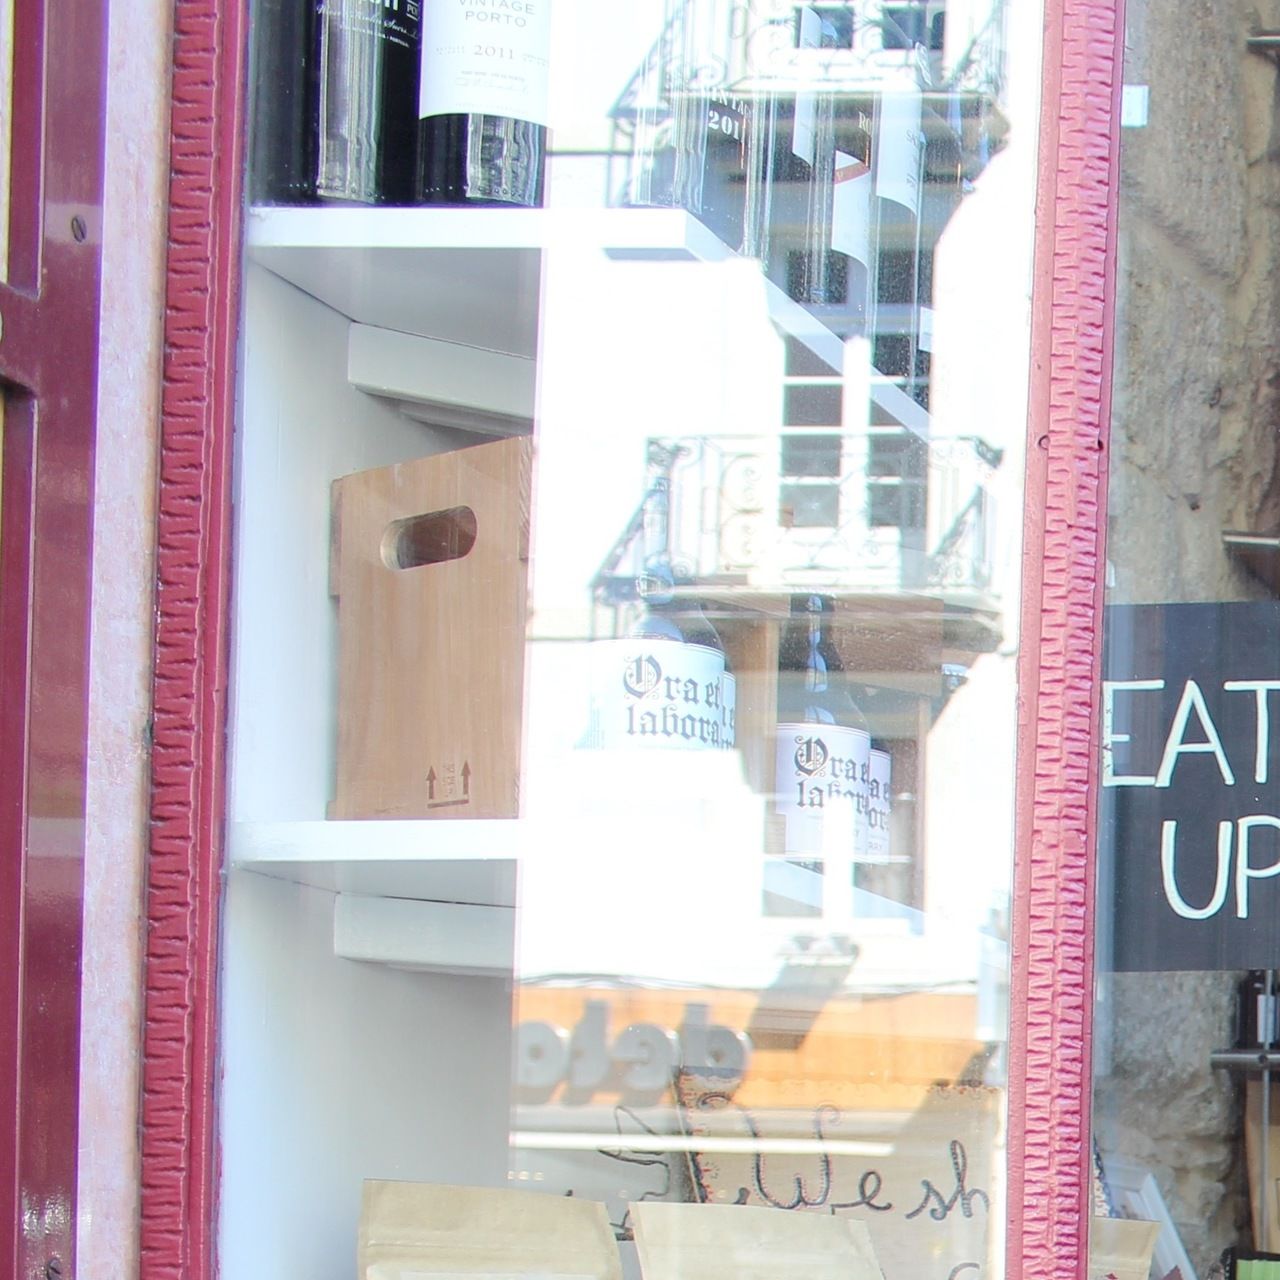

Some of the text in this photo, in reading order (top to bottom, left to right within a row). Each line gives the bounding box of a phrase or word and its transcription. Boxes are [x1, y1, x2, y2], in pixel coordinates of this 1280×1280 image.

[465, 10, 527, 28] PORTO
[473, 44, 516, 60] 2011
[707, 110, 741, 140] 201
